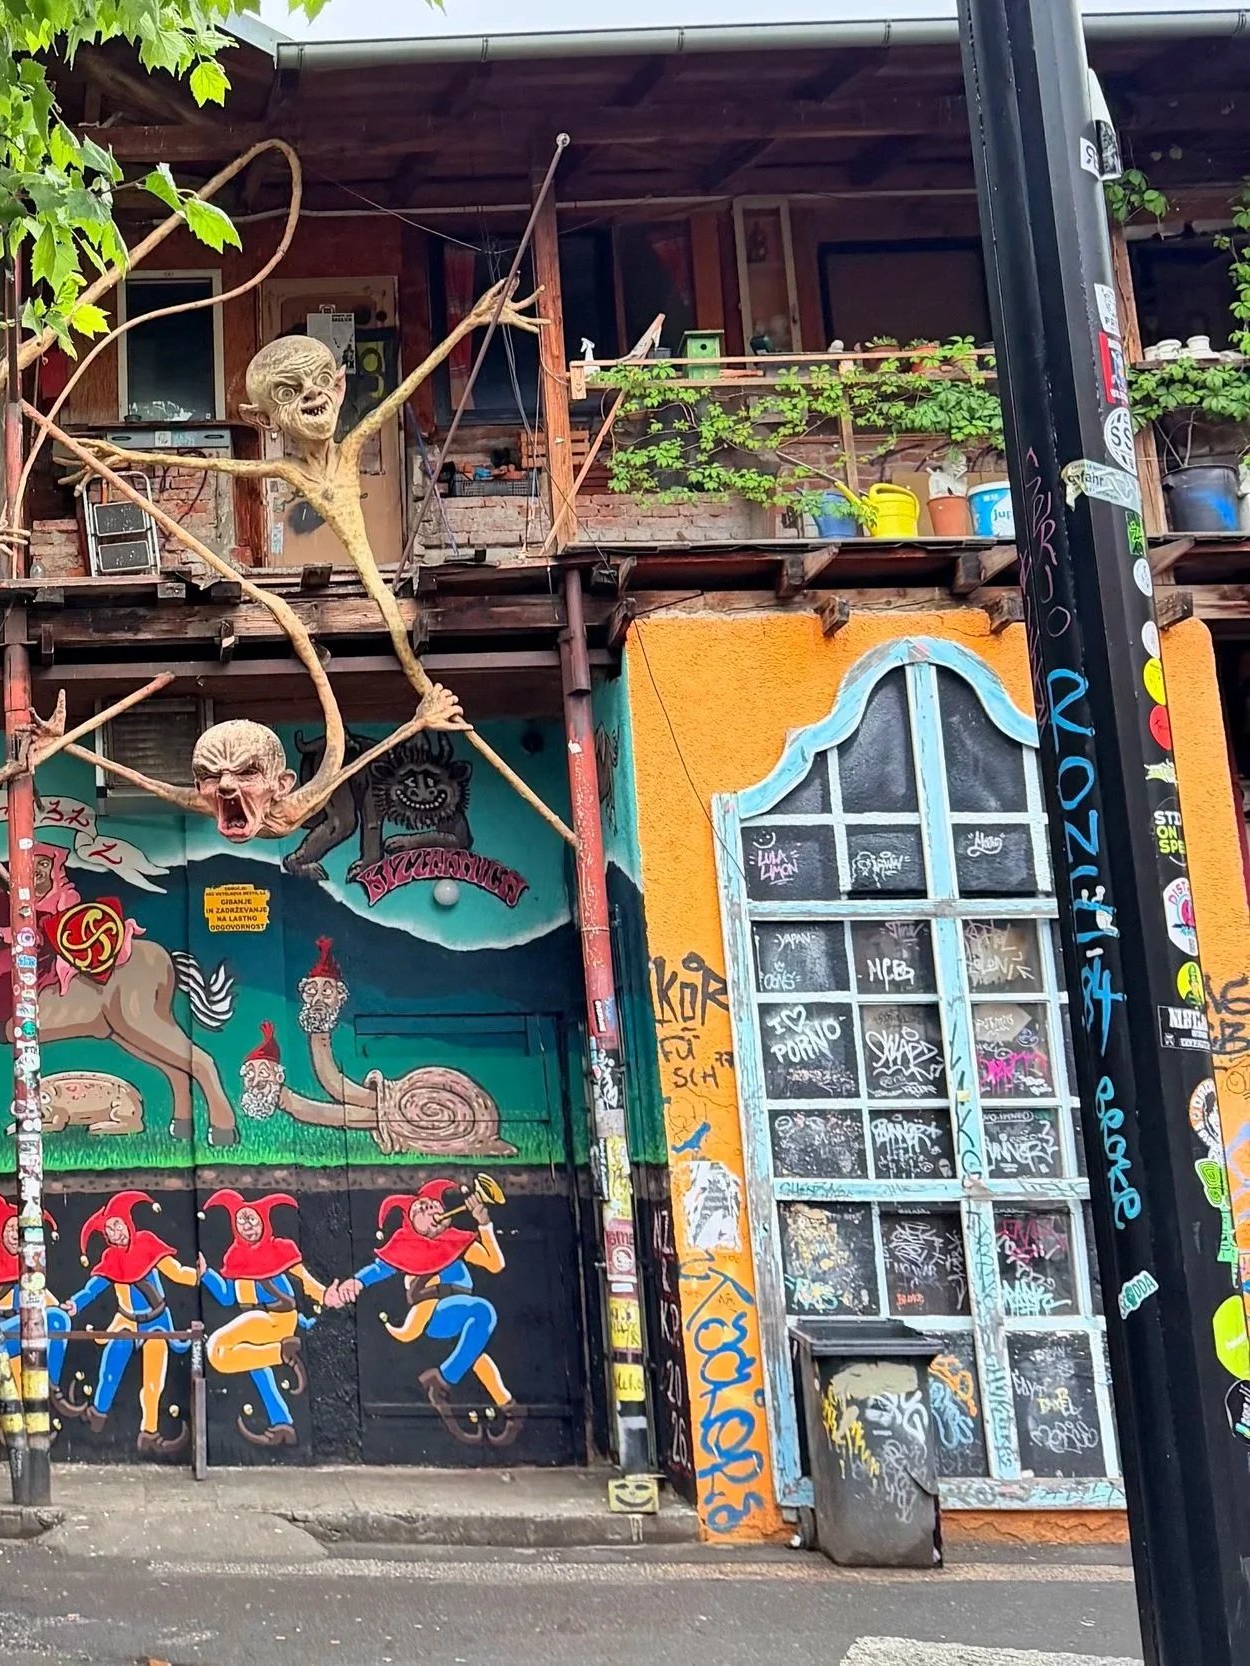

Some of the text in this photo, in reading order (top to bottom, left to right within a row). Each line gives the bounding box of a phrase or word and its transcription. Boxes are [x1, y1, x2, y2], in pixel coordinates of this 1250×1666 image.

[1156, 825, 1178, 839] ON
[215, 905, 268, 914] ZADRŽEVANJE
[210, 923, 265, 931] ODGOVORNOST
[771, 1019, 842, 1064] PORNO
